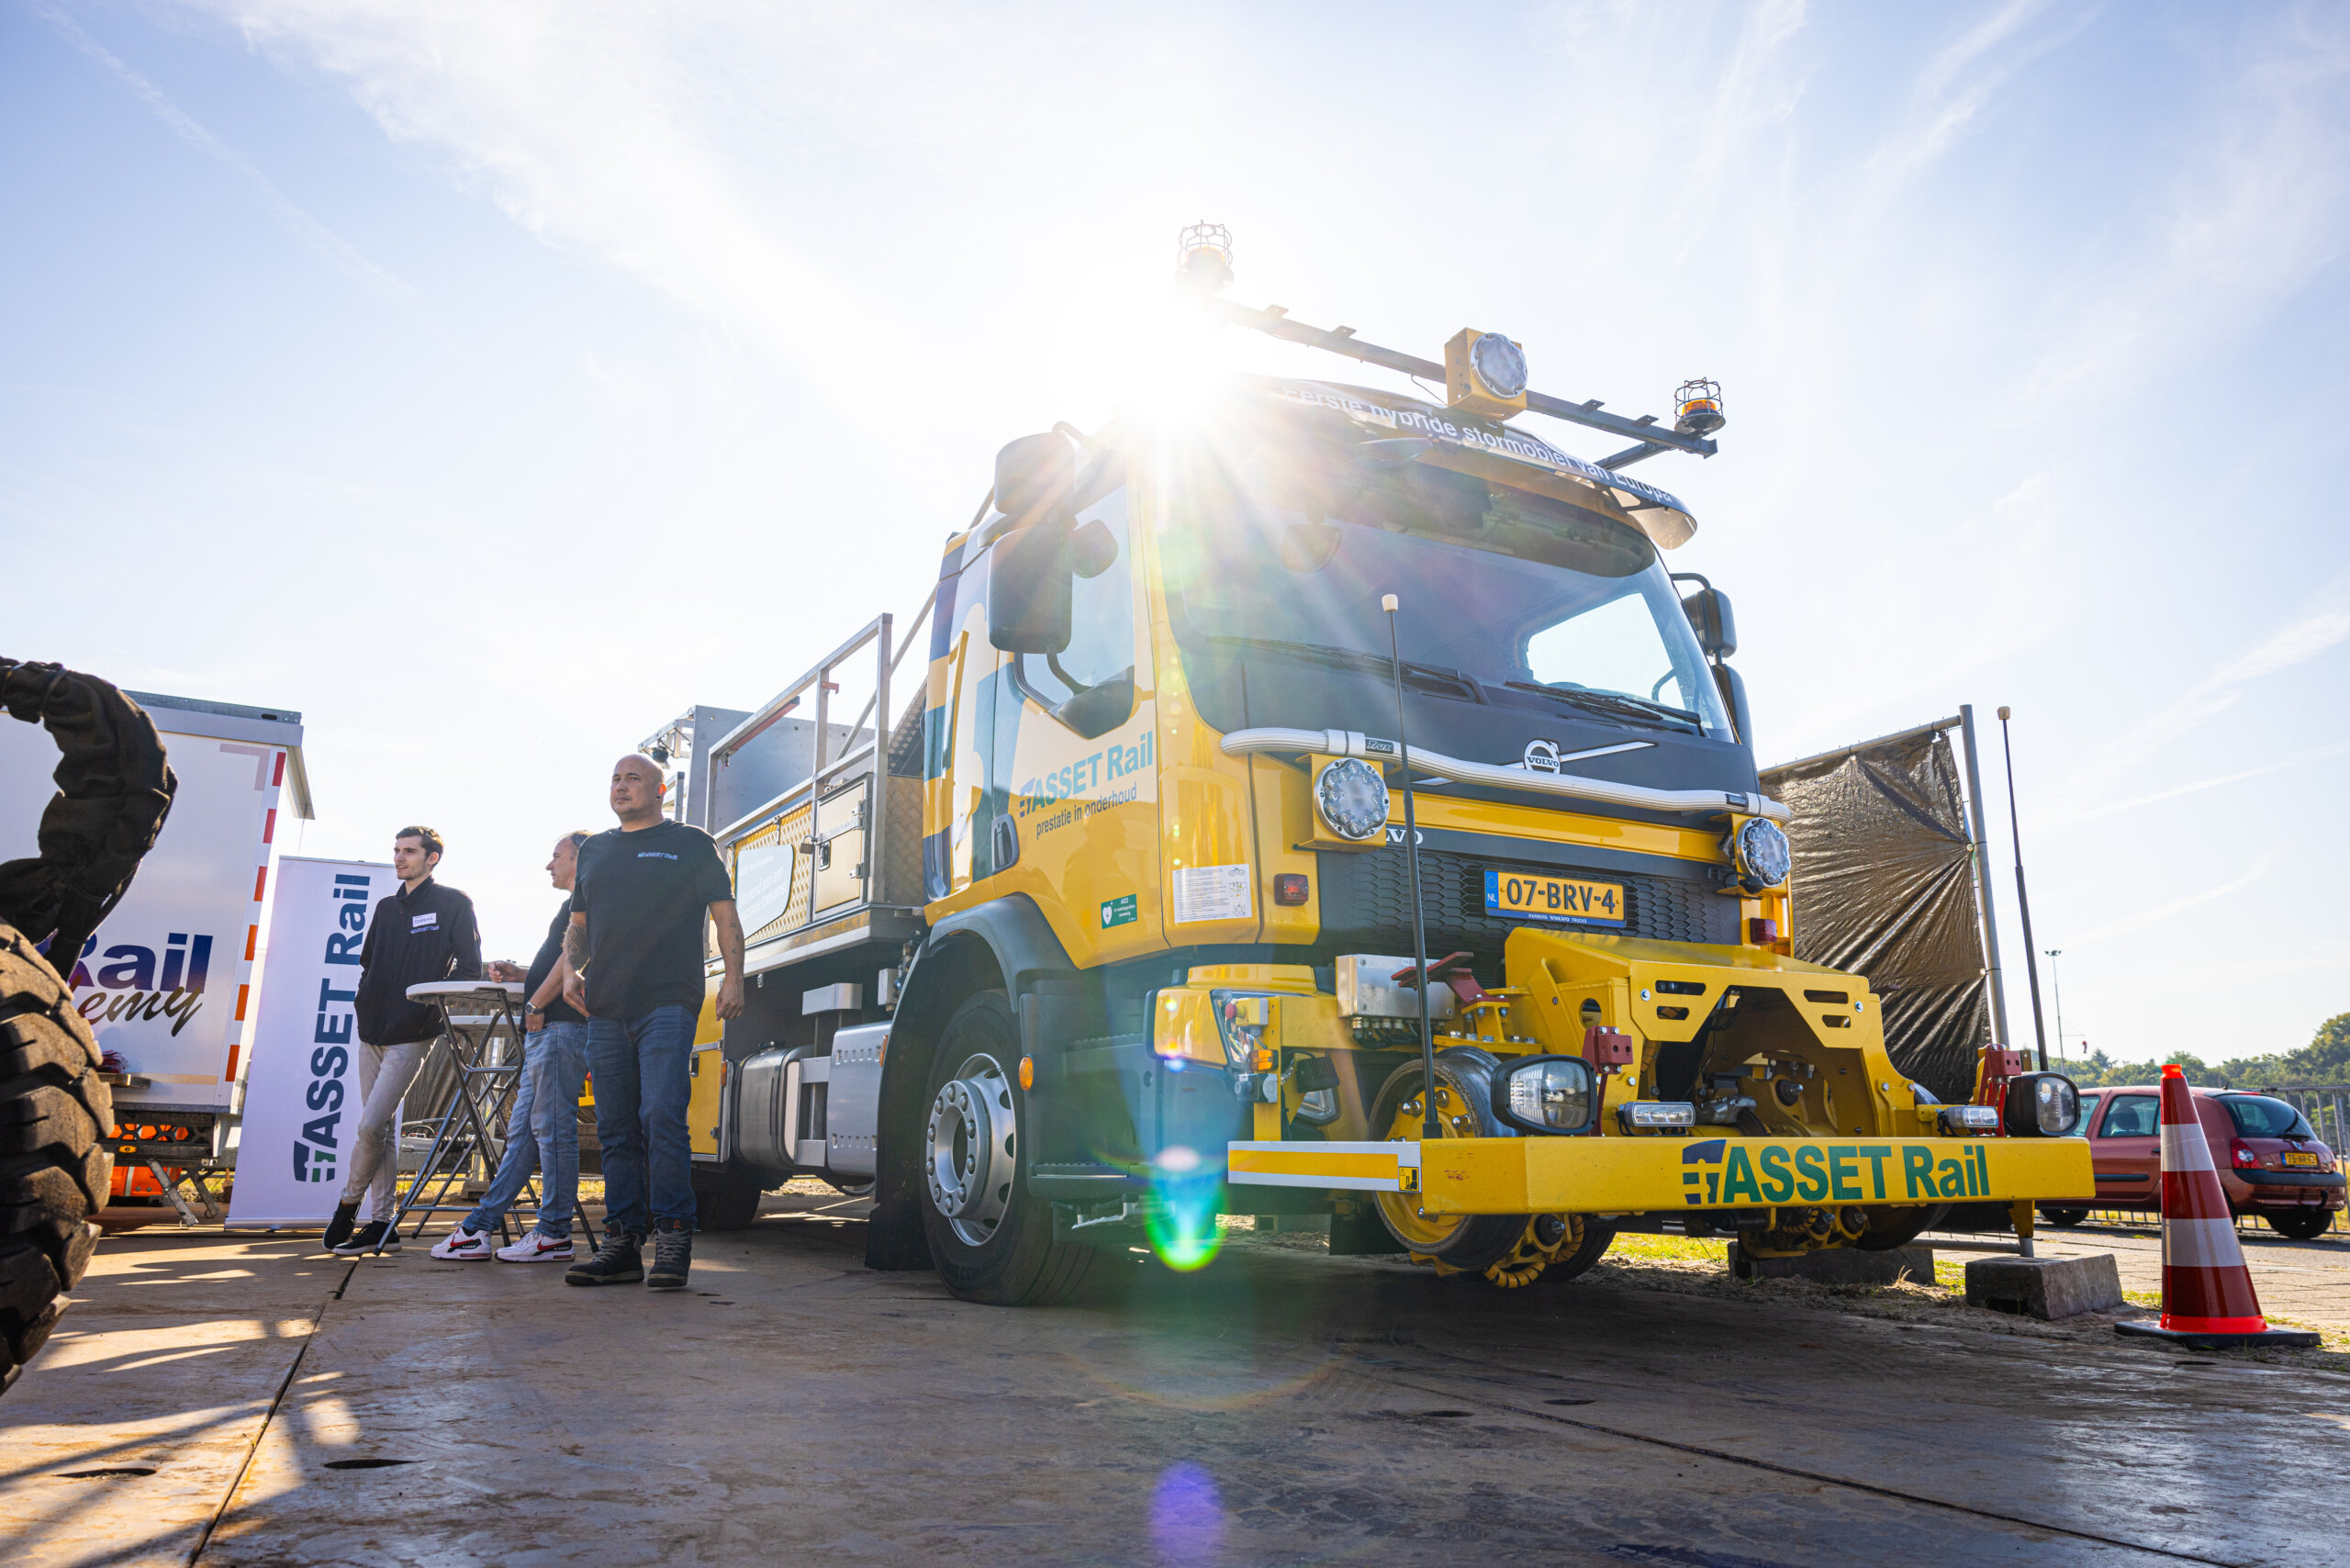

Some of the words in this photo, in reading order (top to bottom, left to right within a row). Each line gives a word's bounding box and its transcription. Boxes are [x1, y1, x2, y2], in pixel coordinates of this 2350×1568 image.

[1575, 460, 1611, 480] van
[1615, 473, 1673, 503] Europa
[1032, 751, 1103, 812] ASSET
[1107, 730, 1153, 782] Rail
[1527, 756, 1560, 767] VOLVO
[1036, 808, 1072, 841] prestatie
[1074, 804, 1083, 822] in
[1084, 781, 1137, 818] onderhoud
[324, 873, 371, 966] Rail
[1486, 892, 1497, 902] NL
[1506, 878, 1616, 914] 07-BRV-4
[301, 978, 357, 1149] ASSET
[1722, 1145, 1893, 1204] ASSET
[1901, 1145, 1991, 1199] Rail
